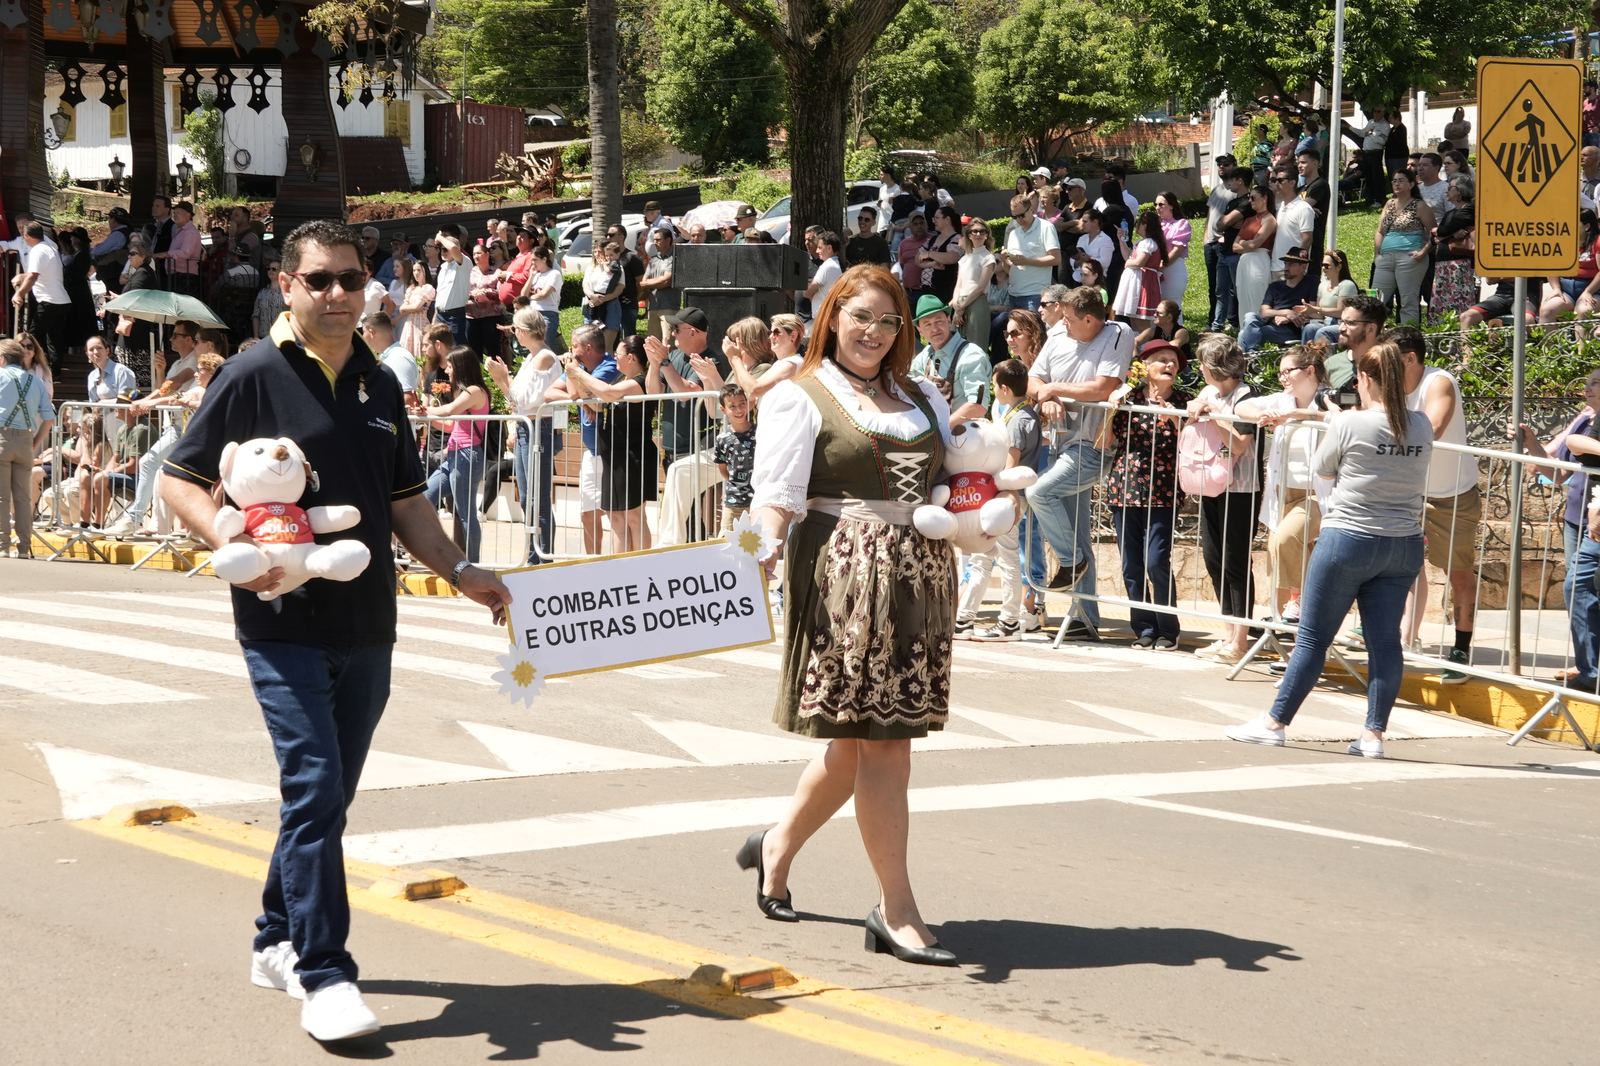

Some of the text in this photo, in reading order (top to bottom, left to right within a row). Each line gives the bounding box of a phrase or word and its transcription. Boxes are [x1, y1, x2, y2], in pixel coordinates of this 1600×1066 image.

[1485, 221, 1571, 237] TRAVESSIA
[1492, 242, 1563, 257] ELEVADA
[1376, 444, 1423, 457] STAFF
[949, 492, 982, 506] POLIO
[952, 486, 976, 497] END
[532, 570, 738, 618] COMBATE À POLIO
[525, 597, 755, 649] E OUTRAS DOENÇAS
